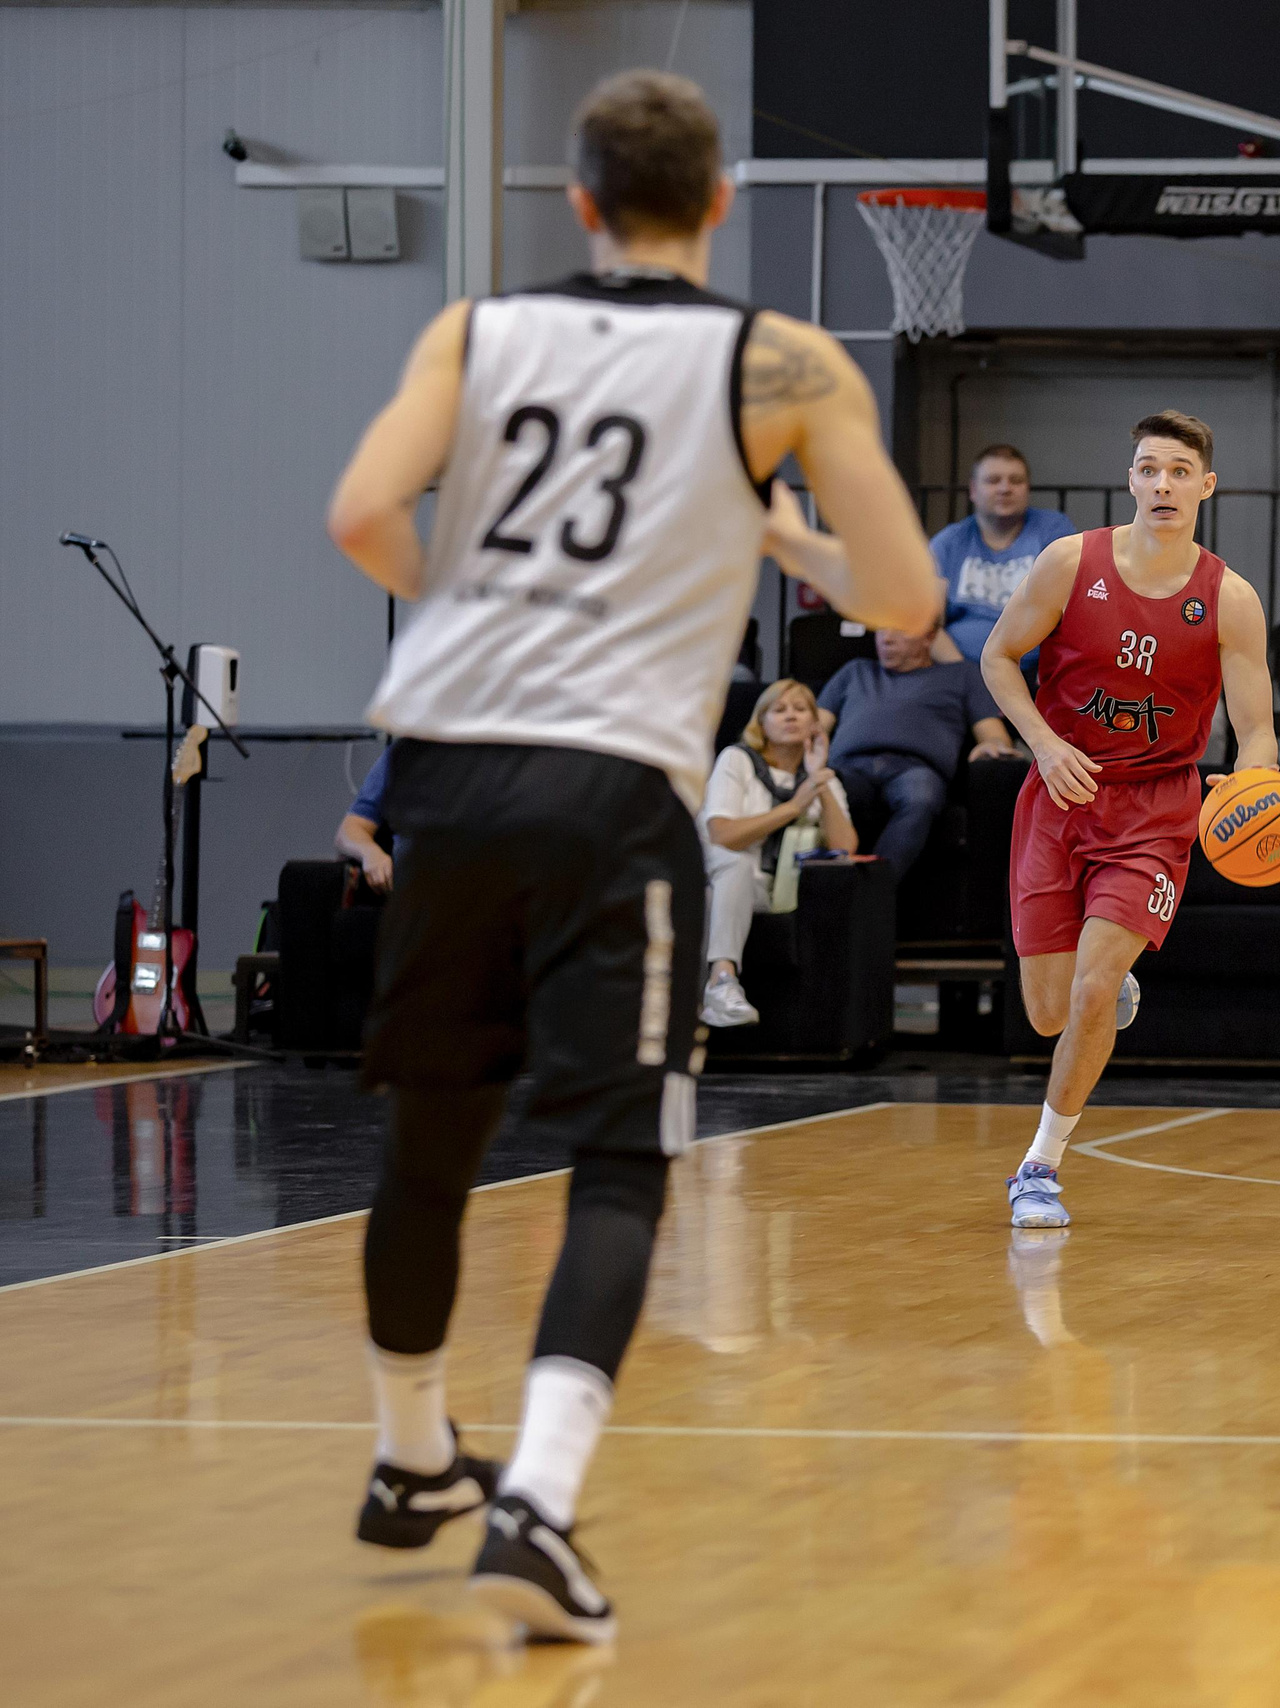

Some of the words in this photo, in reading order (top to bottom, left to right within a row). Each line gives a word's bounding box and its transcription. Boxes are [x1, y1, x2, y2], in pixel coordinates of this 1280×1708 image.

[482, 405, 646, 562] 23
[1087, 589, 1110, 601] PEAK
[1115, 629, 1158, 677] 38
[1147, 872, 1176, 922] 38
